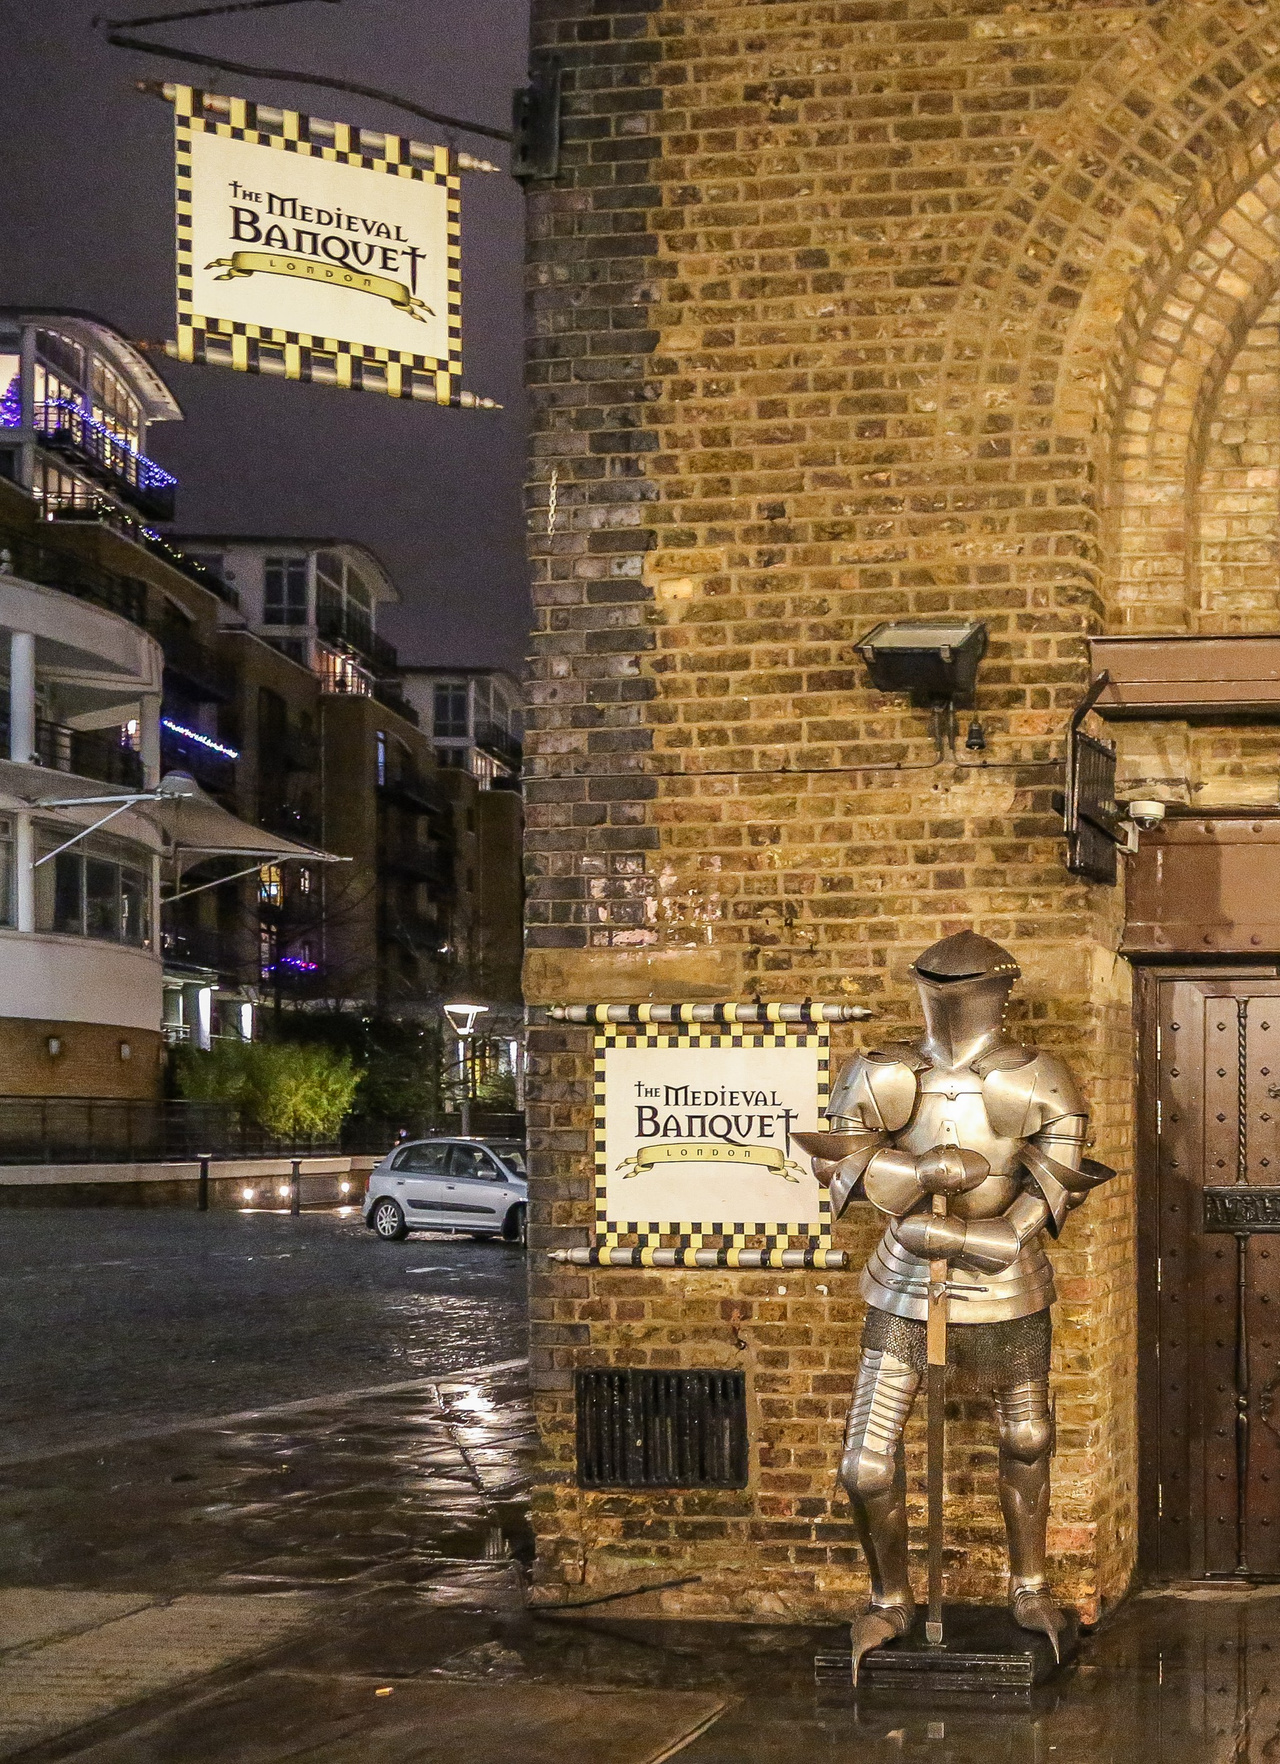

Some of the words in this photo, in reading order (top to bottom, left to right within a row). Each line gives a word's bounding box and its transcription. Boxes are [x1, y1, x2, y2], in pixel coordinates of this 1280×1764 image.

[228, 180, 263, 204] THE
[229, 205, 427, 295] BANQUET
[269, 259, 372, 287] LONDON
[634, 1081, 661, 1098] THE
[634, 1105, 799, 1158] BANQUET
[666, 1148, 751, 1158] LONDON
